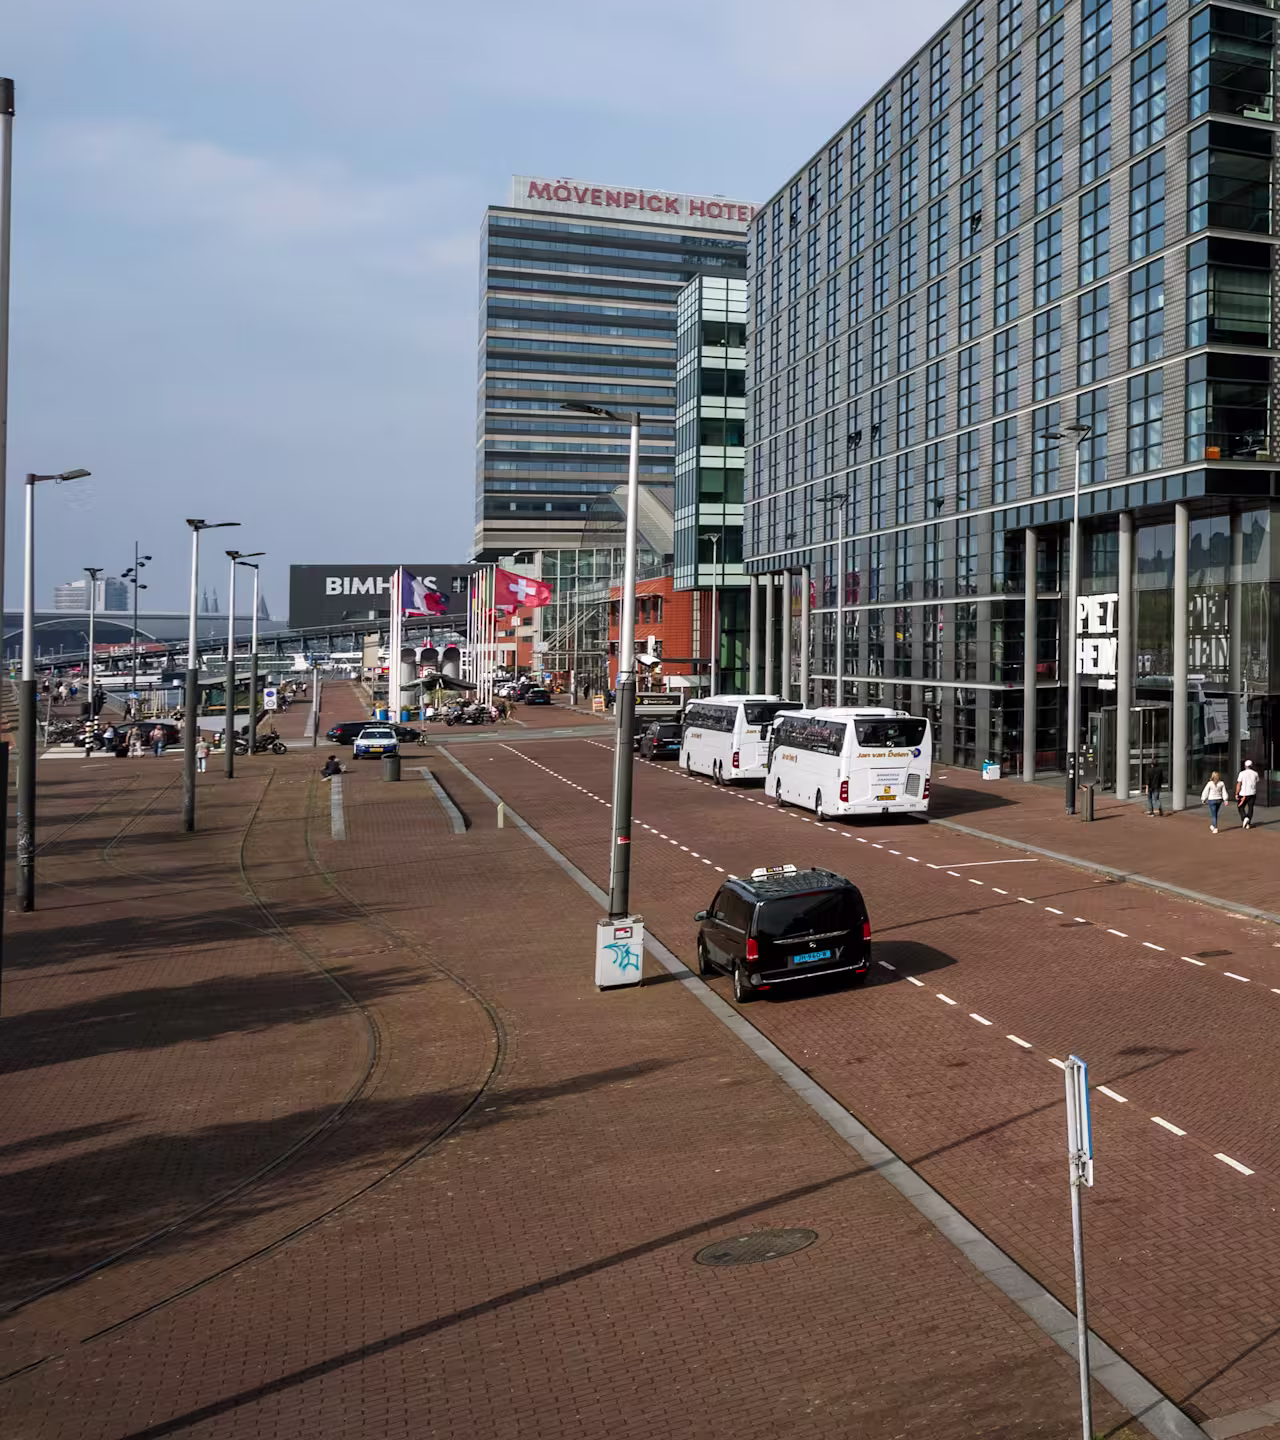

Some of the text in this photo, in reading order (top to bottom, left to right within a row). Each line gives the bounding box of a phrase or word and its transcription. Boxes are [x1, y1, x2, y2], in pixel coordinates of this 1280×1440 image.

[527, 179, 680, 215] MÖVENPICK
[325, 577, 438, 596] BIMHS
[1077, 593, 1118, 634] PIET
[1076, 637, 1117, 676] HEIN
